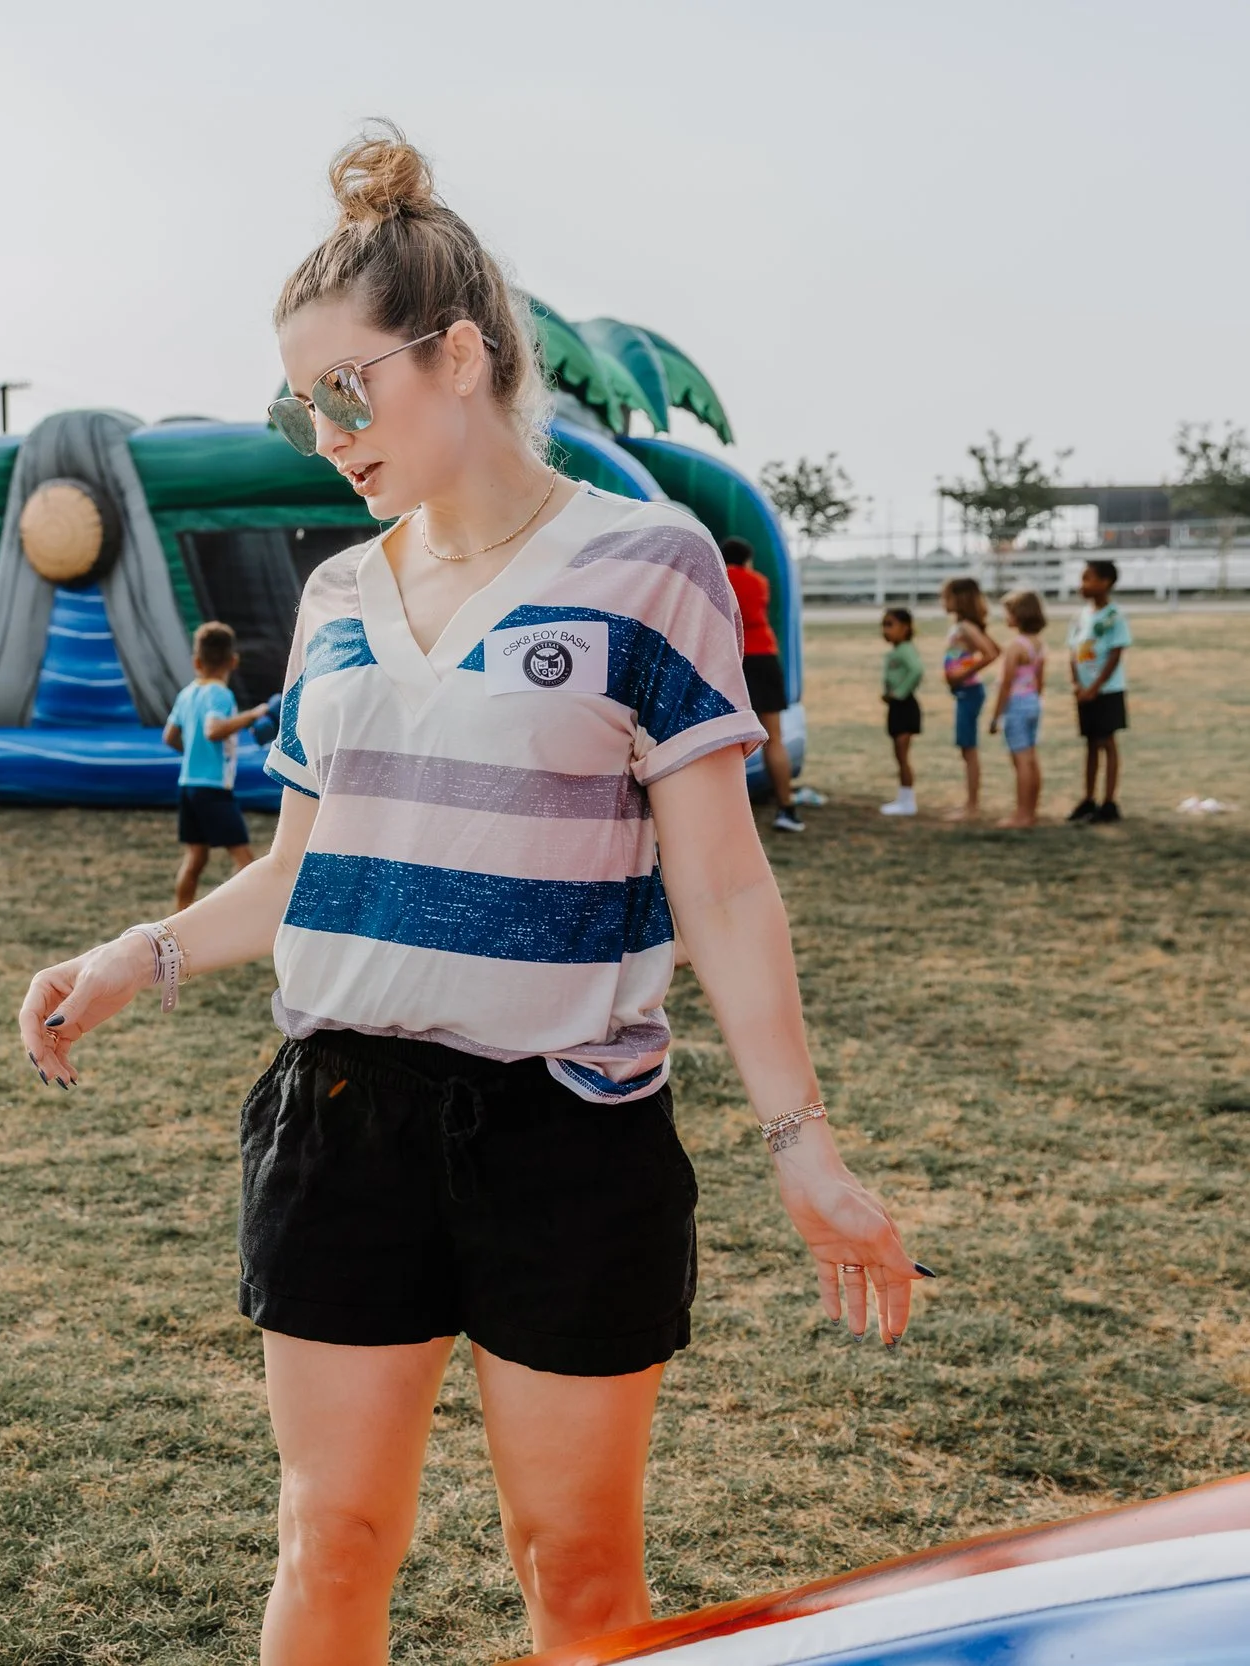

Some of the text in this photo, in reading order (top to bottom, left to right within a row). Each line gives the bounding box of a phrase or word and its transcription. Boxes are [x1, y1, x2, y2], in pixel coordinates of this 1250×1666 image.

[503, 630, 590, 656] CSK8 EOY BASH
